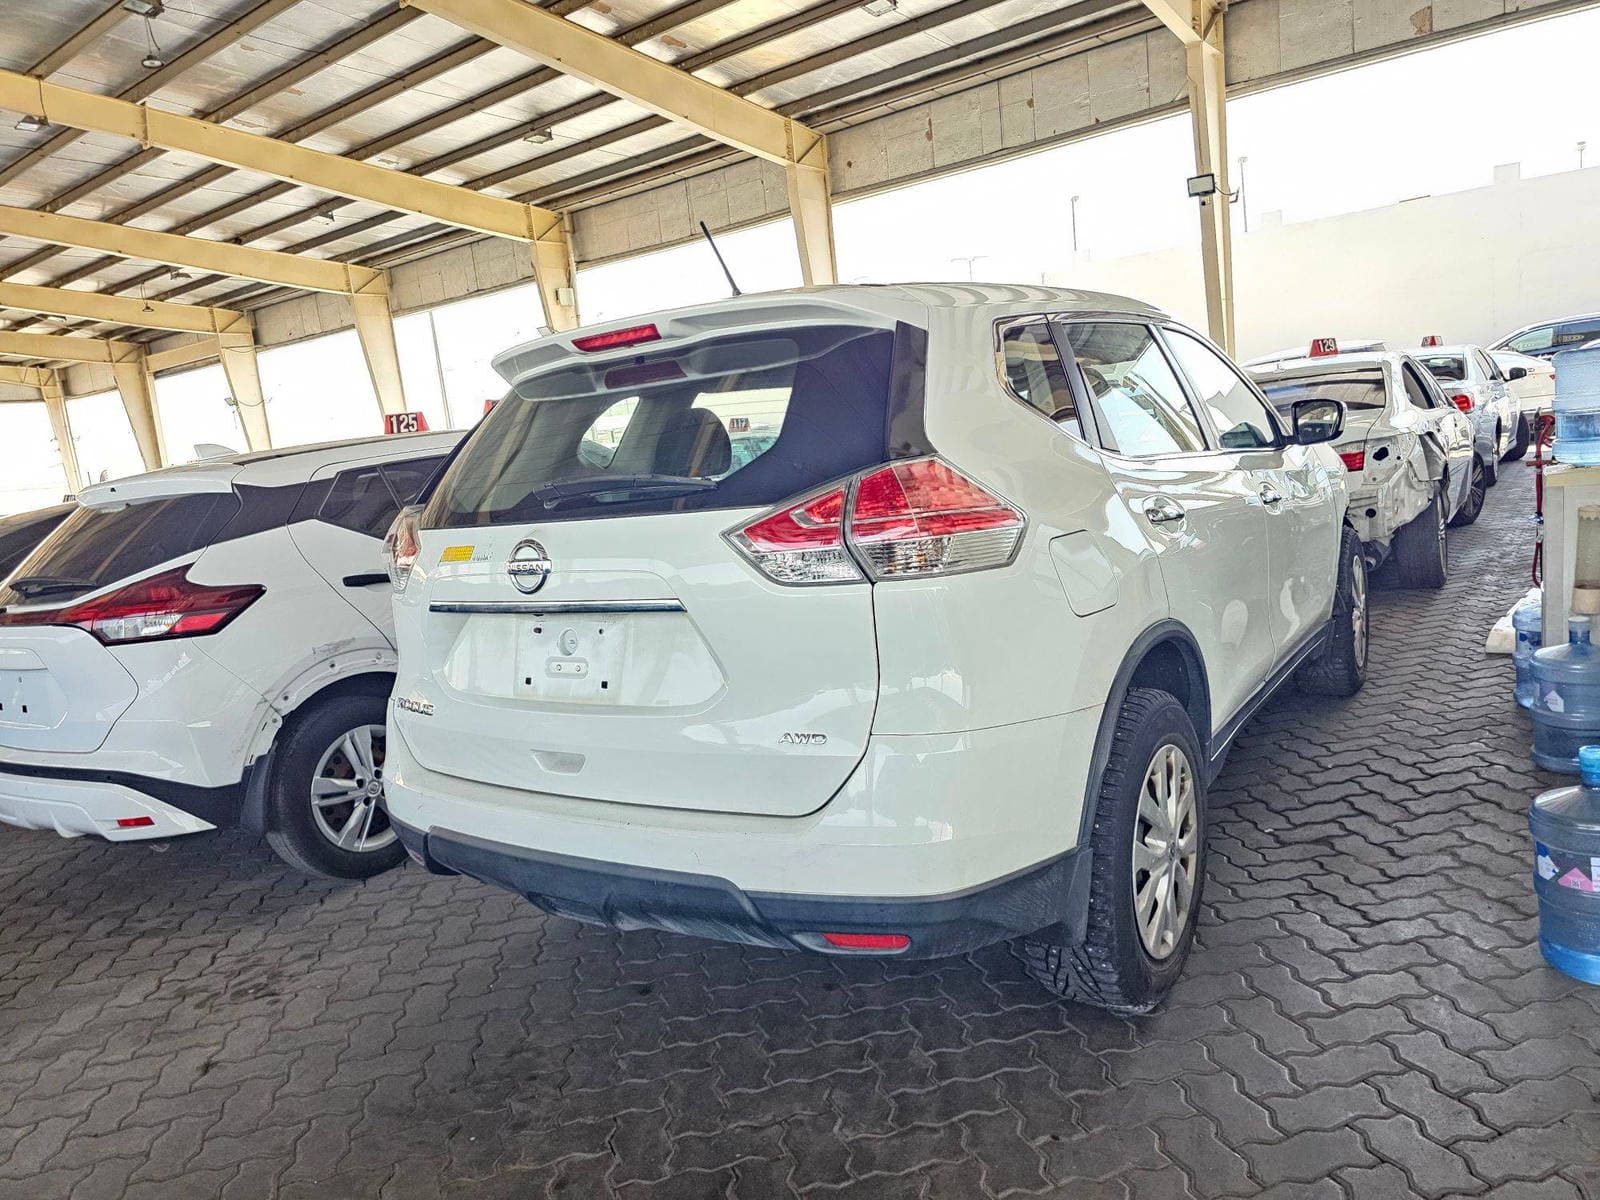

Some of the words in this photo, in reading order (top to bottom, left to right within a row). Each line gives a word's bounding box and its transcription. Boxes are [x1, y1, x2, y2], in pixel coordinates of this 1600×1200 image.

[1318, 339, 1335, 353] 129
[390, 414, 418, 434] 125
[508, 563, 544, 573] NISSAN
[778, 732, 828, 745] AWD
